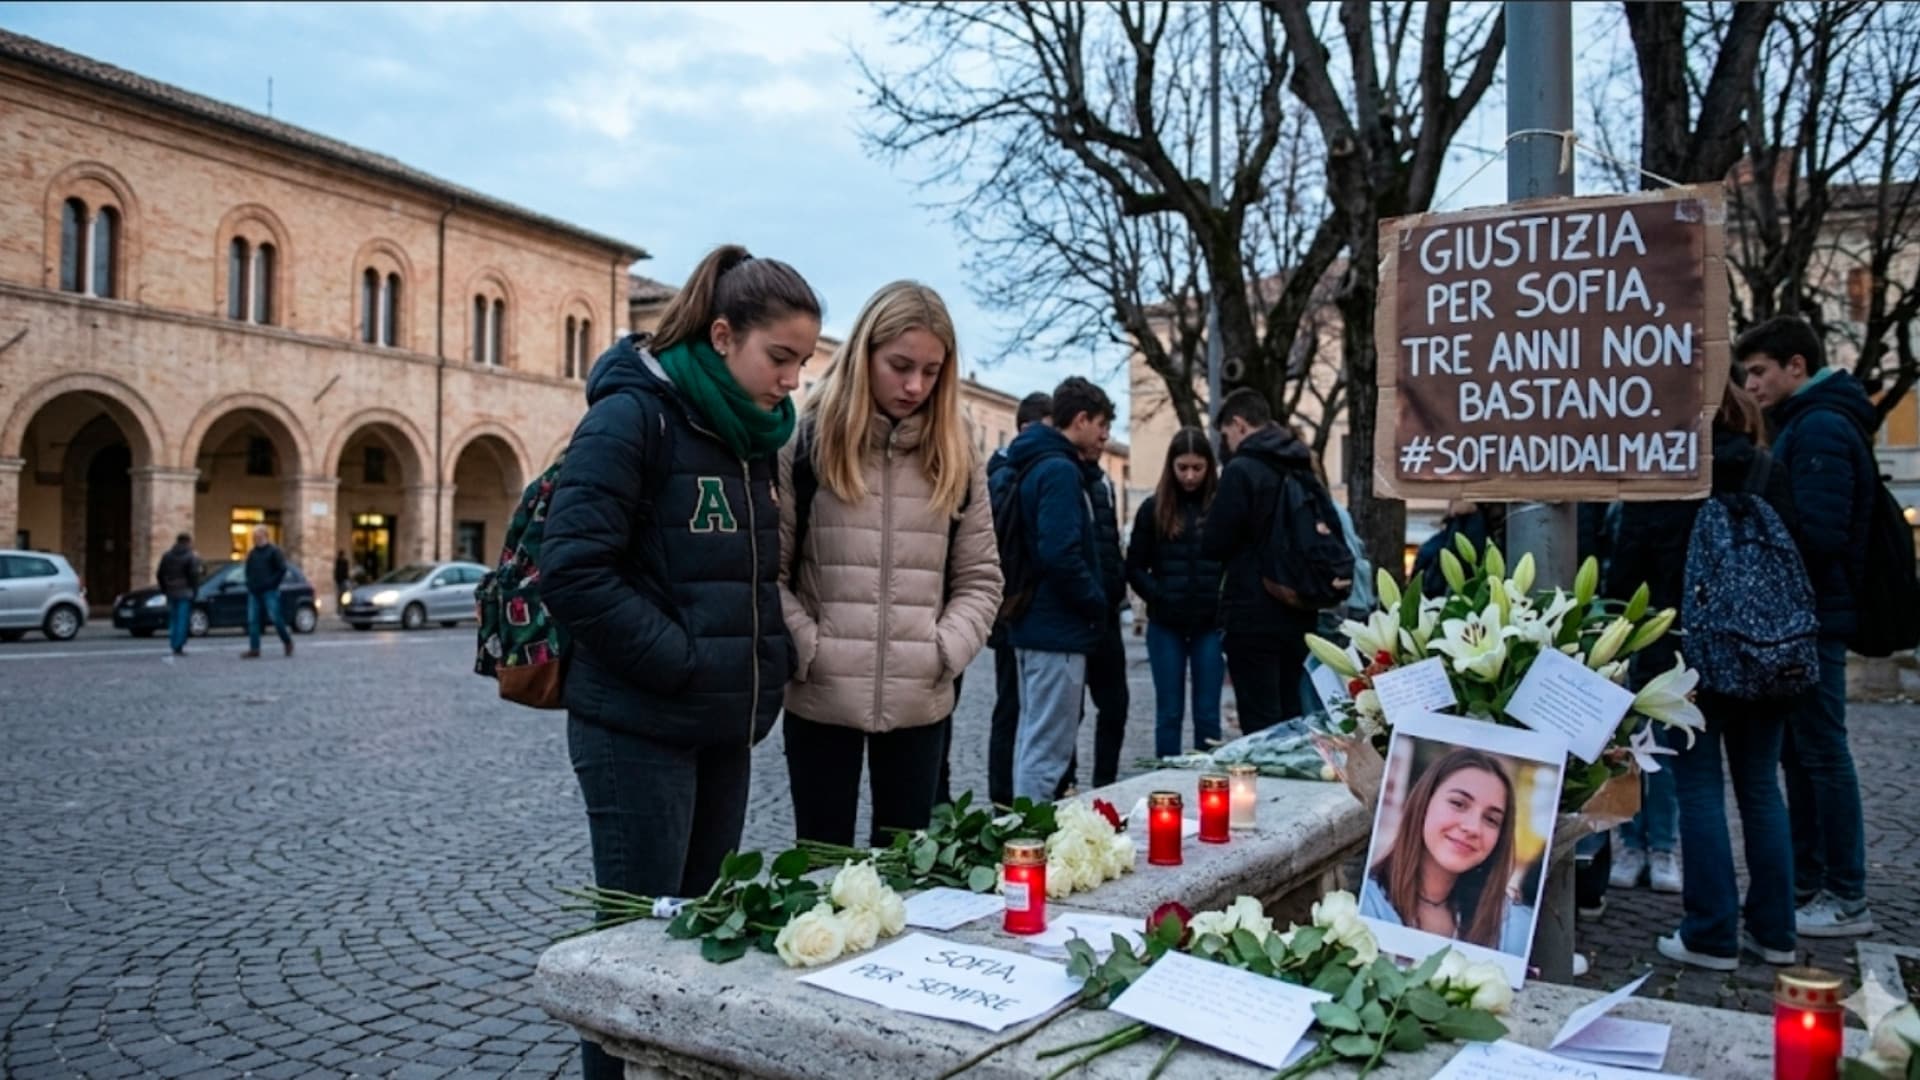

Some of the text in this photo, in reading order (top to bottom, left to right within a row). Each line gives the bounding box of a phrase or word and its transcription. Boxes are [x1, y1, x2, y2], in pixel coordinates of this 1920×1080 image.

[1420, 210, 1646, 274] GIUSTIZIA
[1428, 267, 1665, 325] PER SOFIA,
[1402, 323, 1692, 376] TRE ANNI NON
[1460, 376, 1661, 422] BASTANO.
[1400, 432, 1697, 474] #SOFIADIDALMAZI
[690, 477, 737, 533] A
[850, 963, 1021, 1011] PER SEMPRE
[925, 950, 1015, 983] SOFIA,
